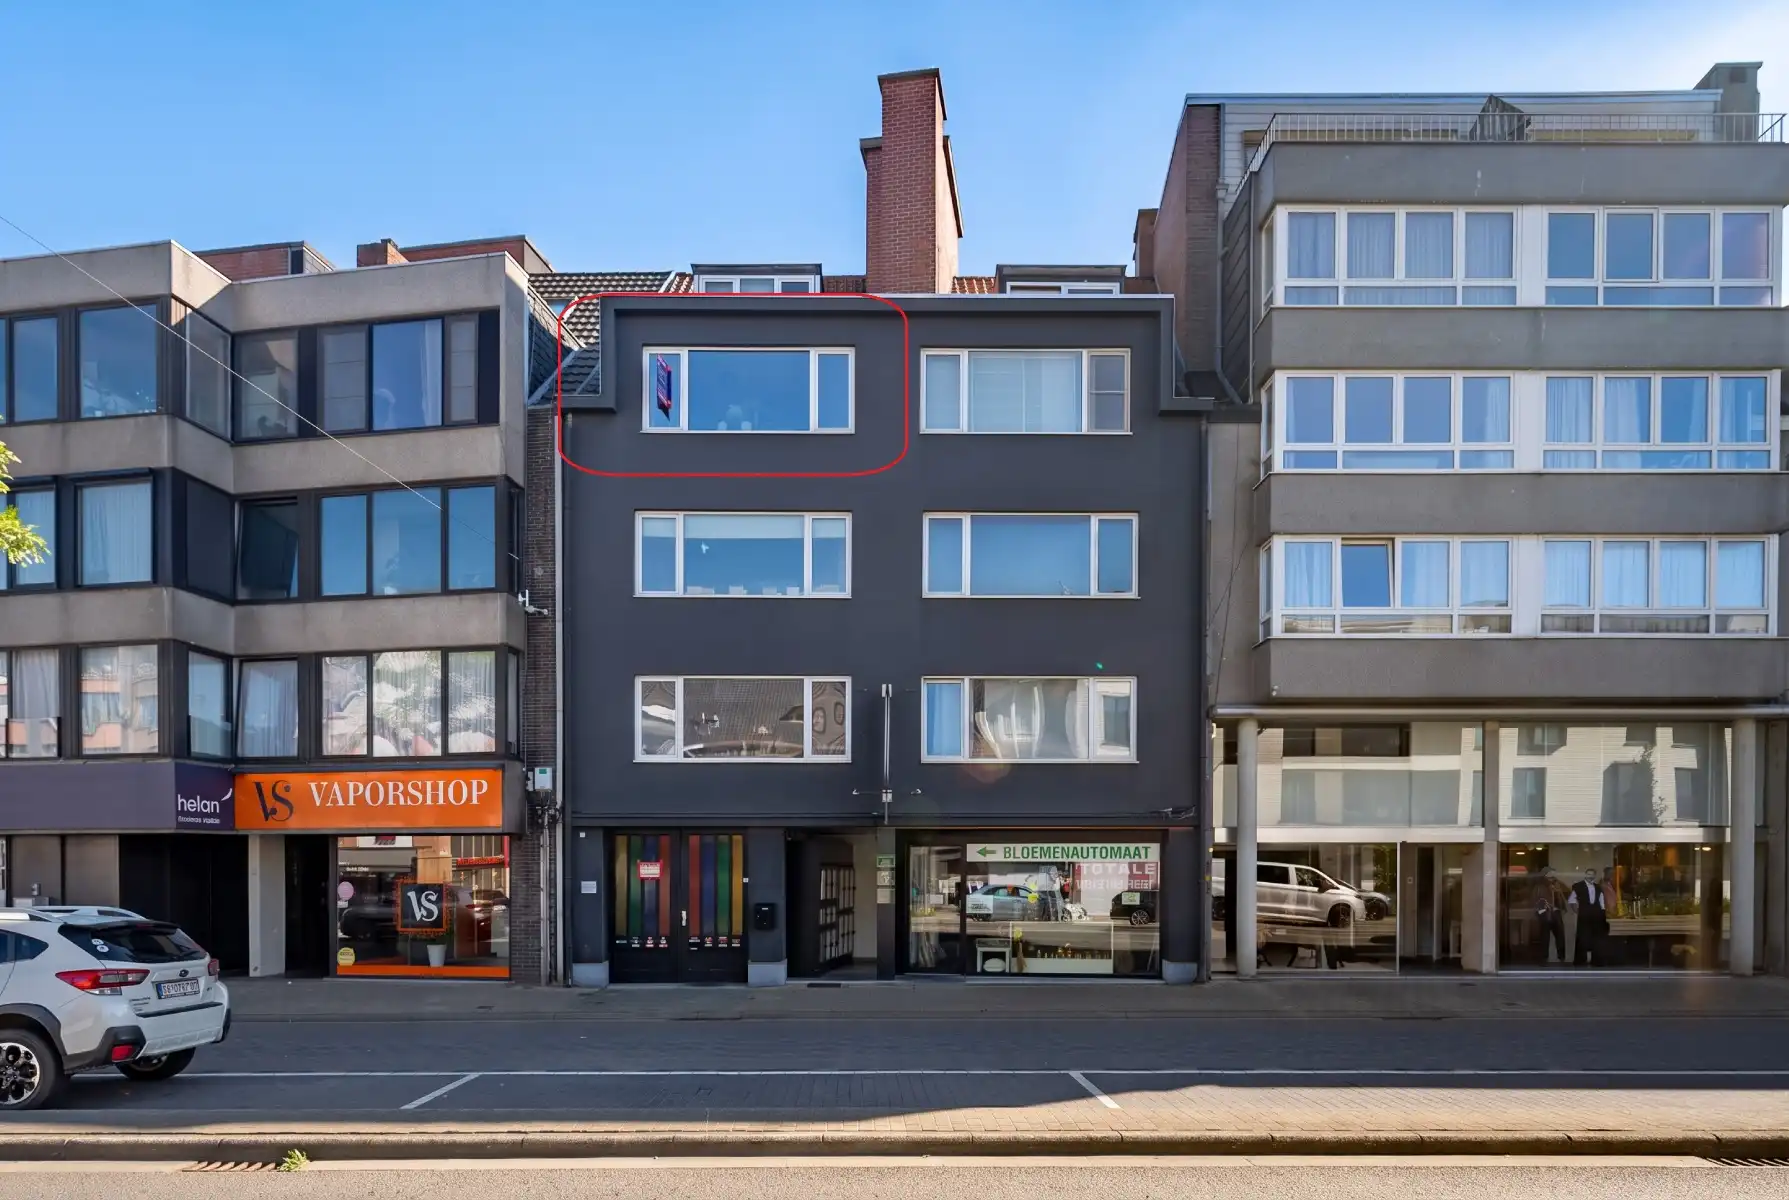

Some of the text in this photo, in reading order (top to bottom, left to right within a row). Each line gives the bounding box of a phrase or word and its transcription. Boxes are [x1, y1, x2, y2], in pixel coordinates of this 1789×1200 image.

[177, 794, 220, 814] helan
[252, 779, 489, 822] VS VAPORSHOP
[1003, 846, 1151, 859] BLOEMENAUTOMAAT
[407, 890, 439, 922] VS
